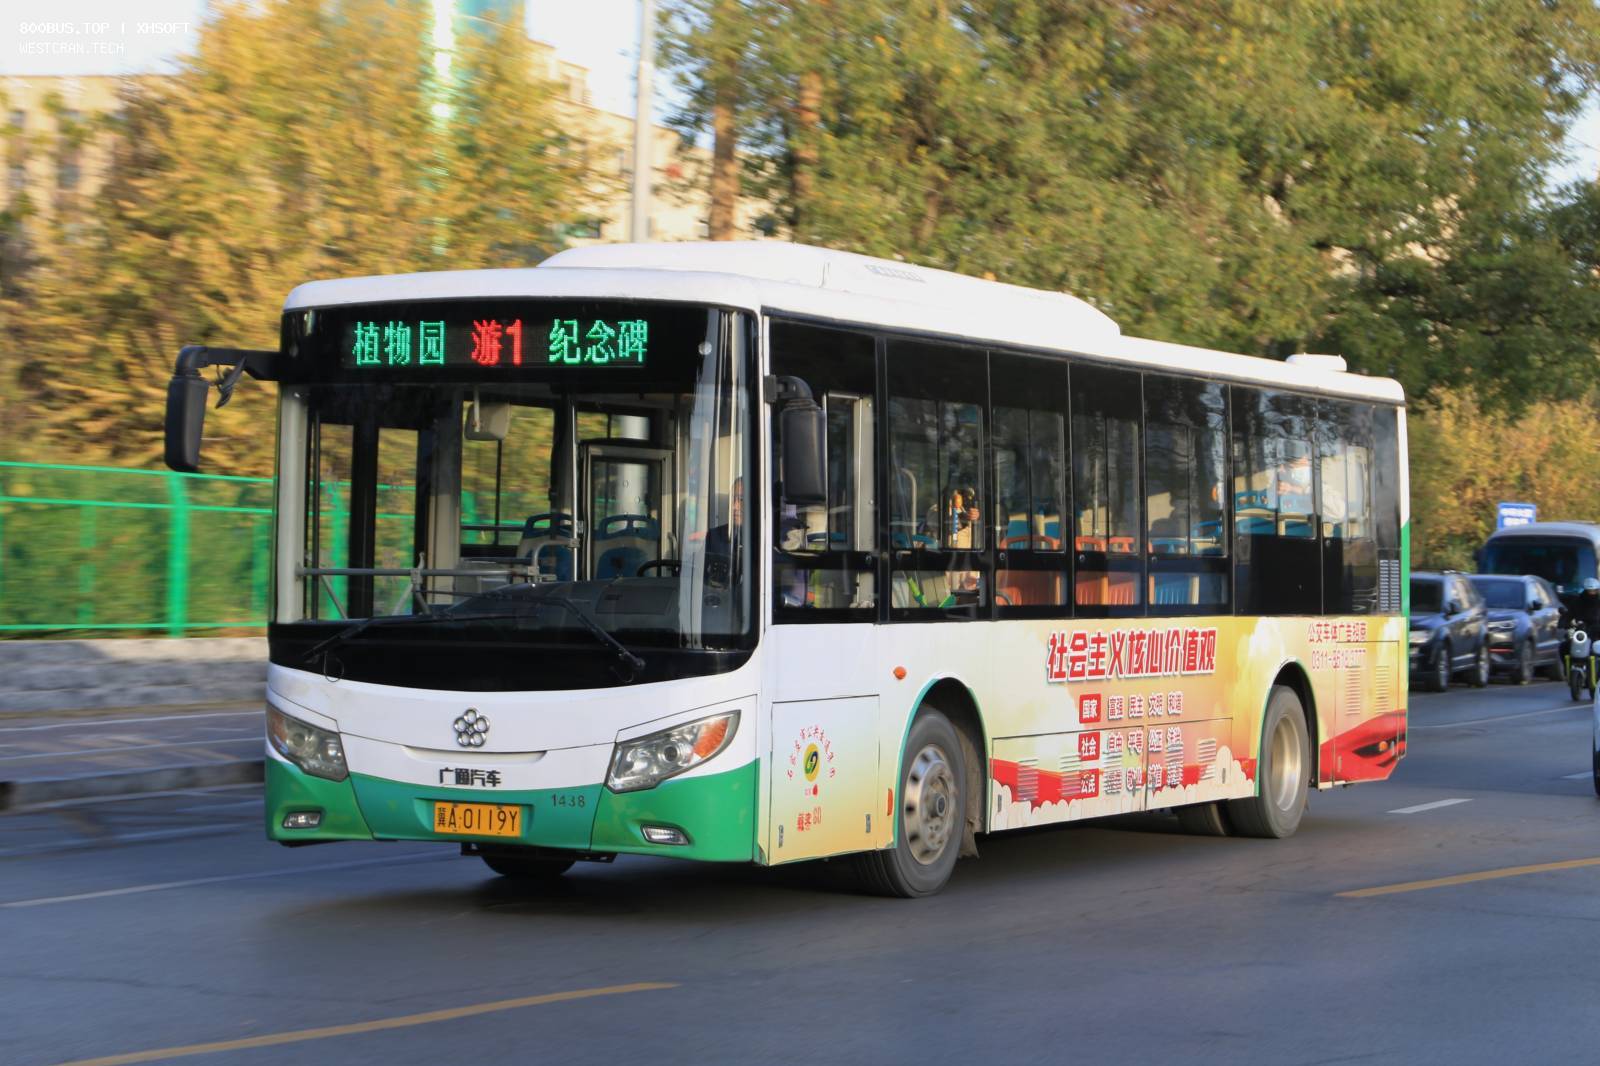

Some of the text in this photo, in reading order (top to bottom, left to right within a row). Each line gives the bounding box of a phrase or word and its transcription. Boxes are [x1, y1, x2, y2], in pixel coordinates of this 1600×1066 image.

[352, 318, 648, 366] 植物园 游1 纪念碑
[1047, 628, 1217, 682] 社会主义核心价值观
[1081, 735, 1097, 757] 社会
[439, 768, 502, 787] 广通汽车
[551, 794, 586, 808] 1438
